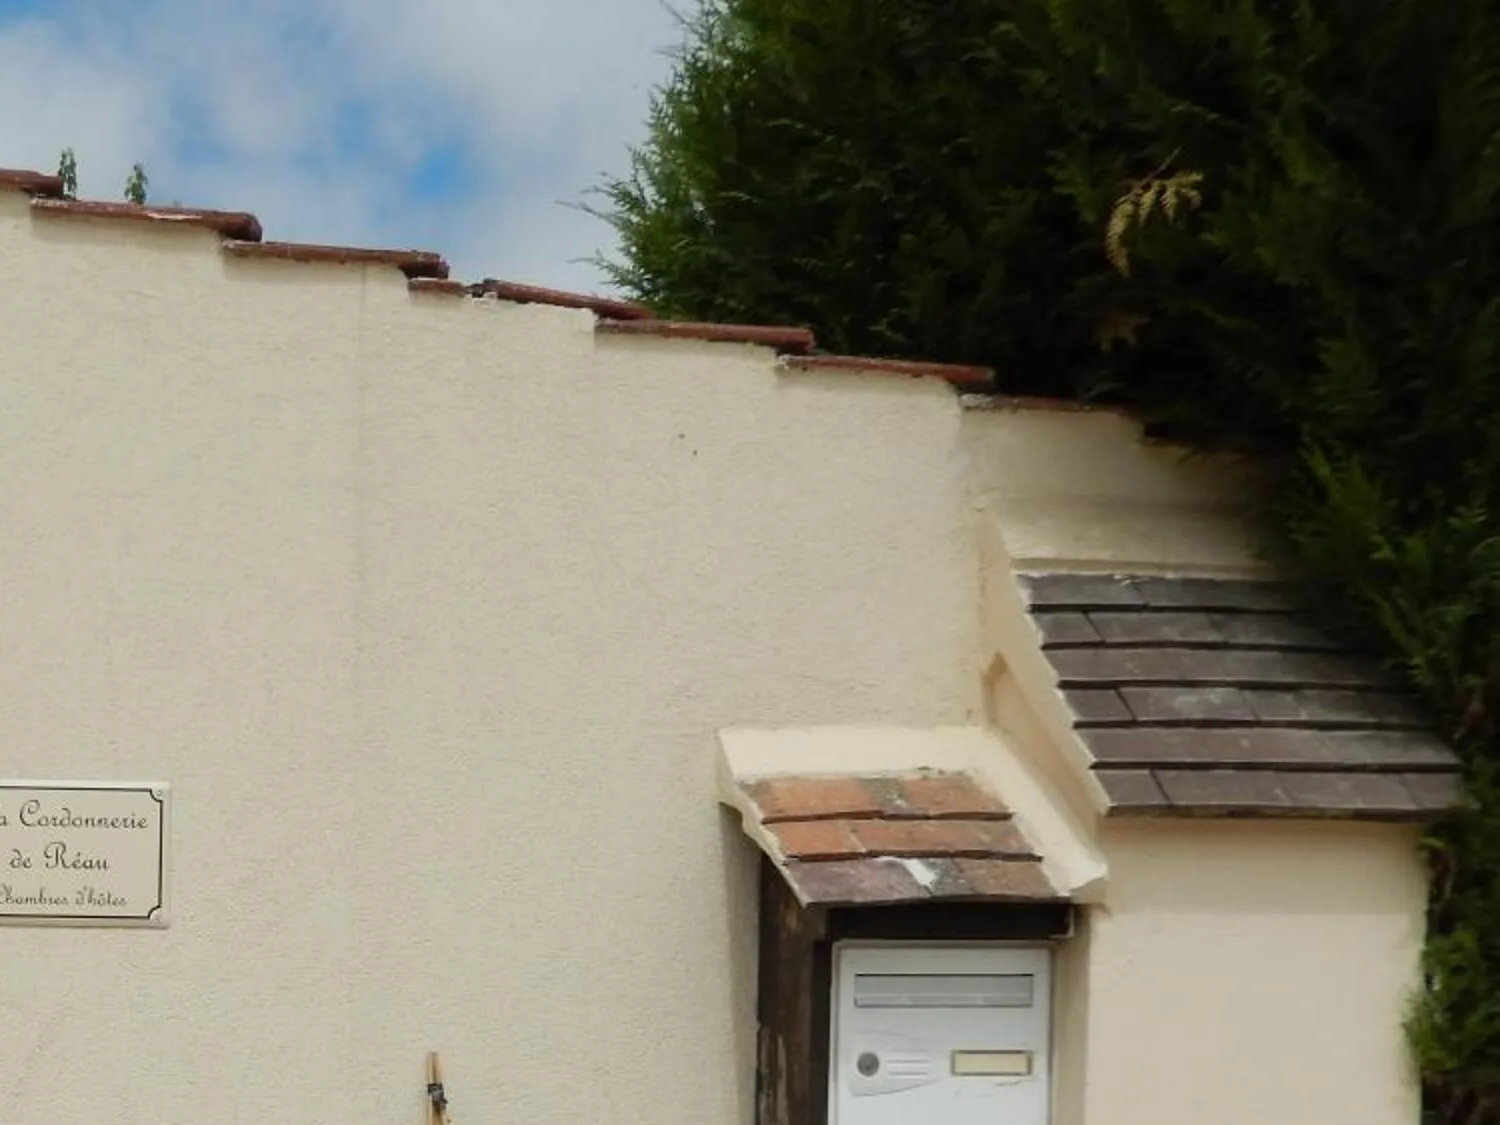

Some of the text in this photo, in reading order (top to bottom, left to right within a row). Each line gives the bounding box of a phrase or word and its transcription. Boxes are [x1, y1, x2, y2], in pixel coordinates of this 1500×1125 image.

[19, 799, 149, 829] Cordonnerie
[9, 841, 109, 870] de Réau
